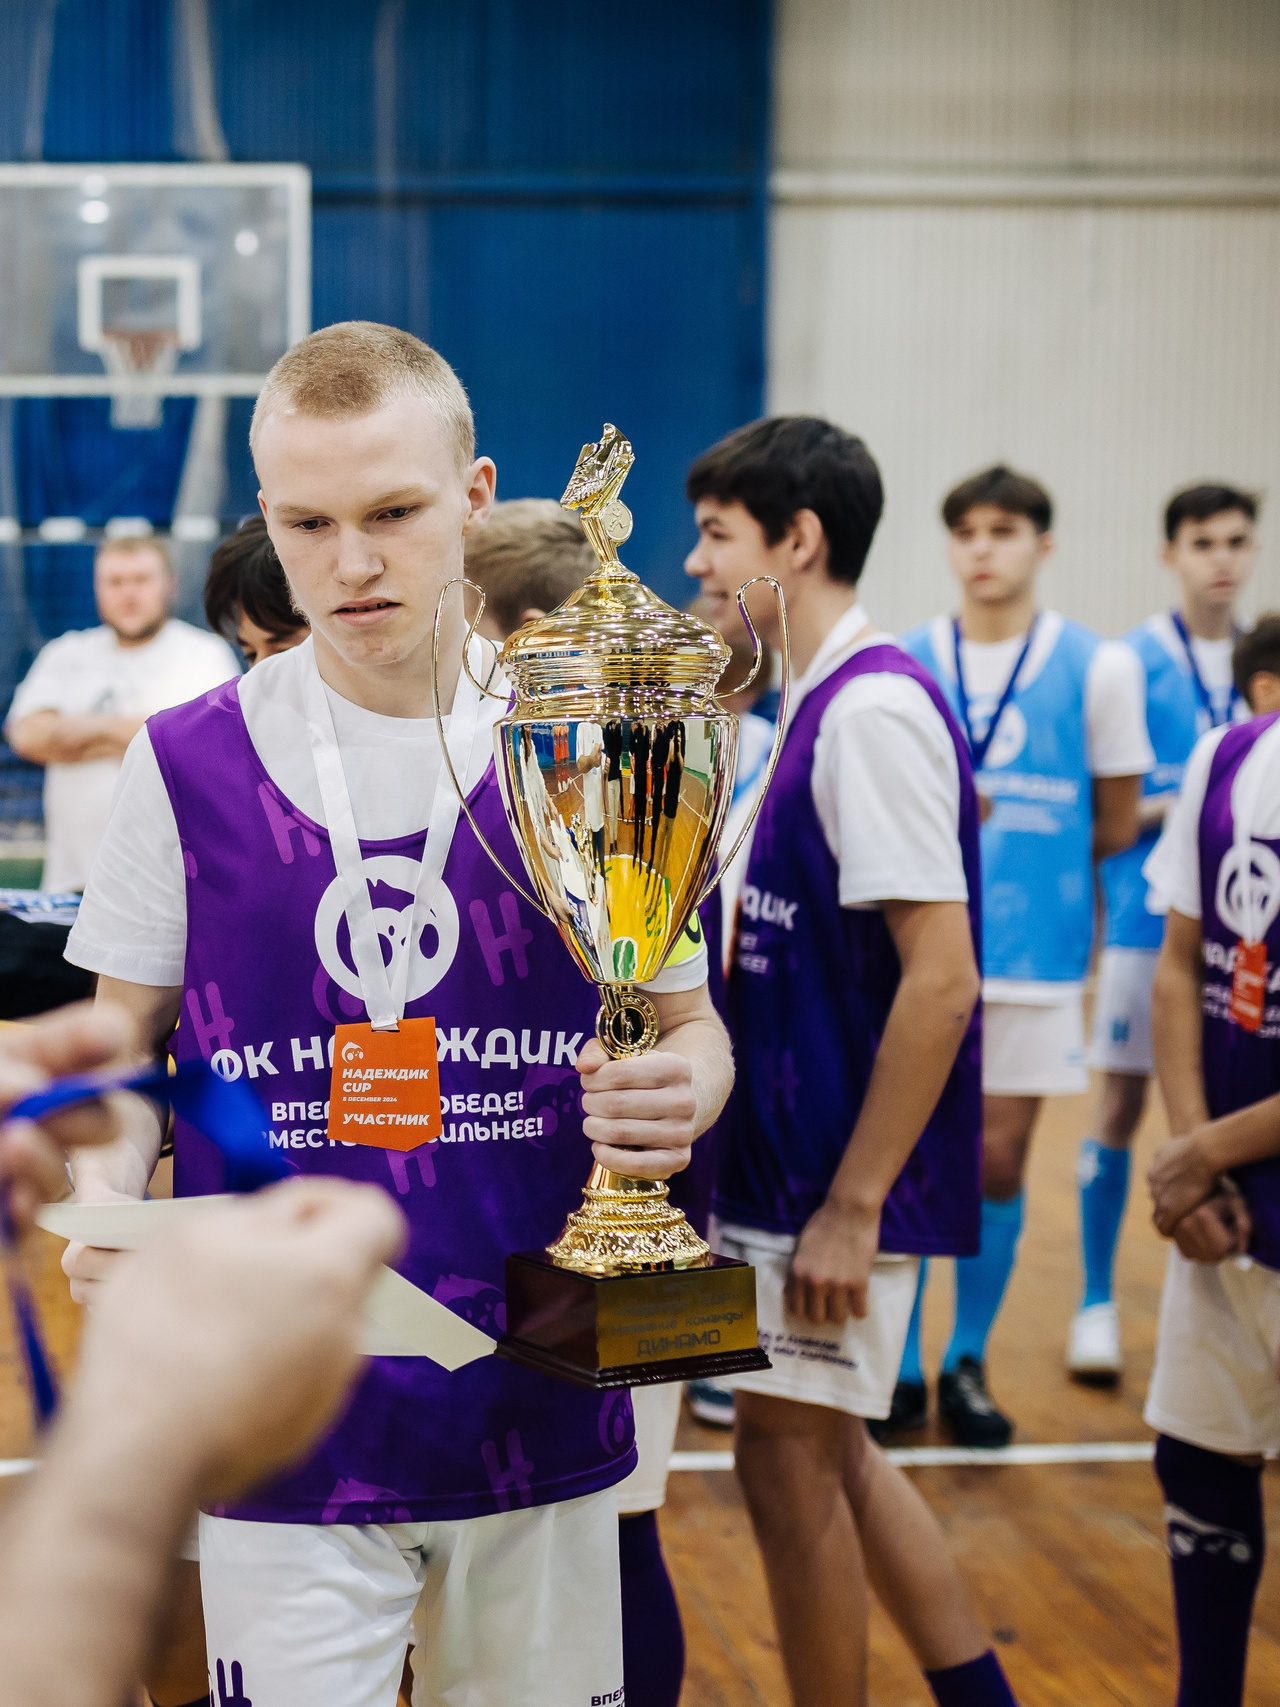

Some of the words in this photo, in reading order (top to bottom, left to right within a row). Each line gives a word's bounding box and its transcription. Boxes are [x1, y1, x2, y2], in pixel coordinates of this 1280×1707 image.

[210, 1041, 280, 1083] ФК
[290, 1027, 584, 1072] НЖДИК
[342, 1068, 430, 1081] НАДЕЖДИК
[342, 1082, 372, 1093] CUP
[439, 1091, 524, 1116] ОБЕДЕ!
[342, 1113, 430, 1126] УЧАСТНИК
[427, 1117, 544, 1143] ИЛЬНЕЕ!
[637, 1328, 721, 1356] ДИНАМО
